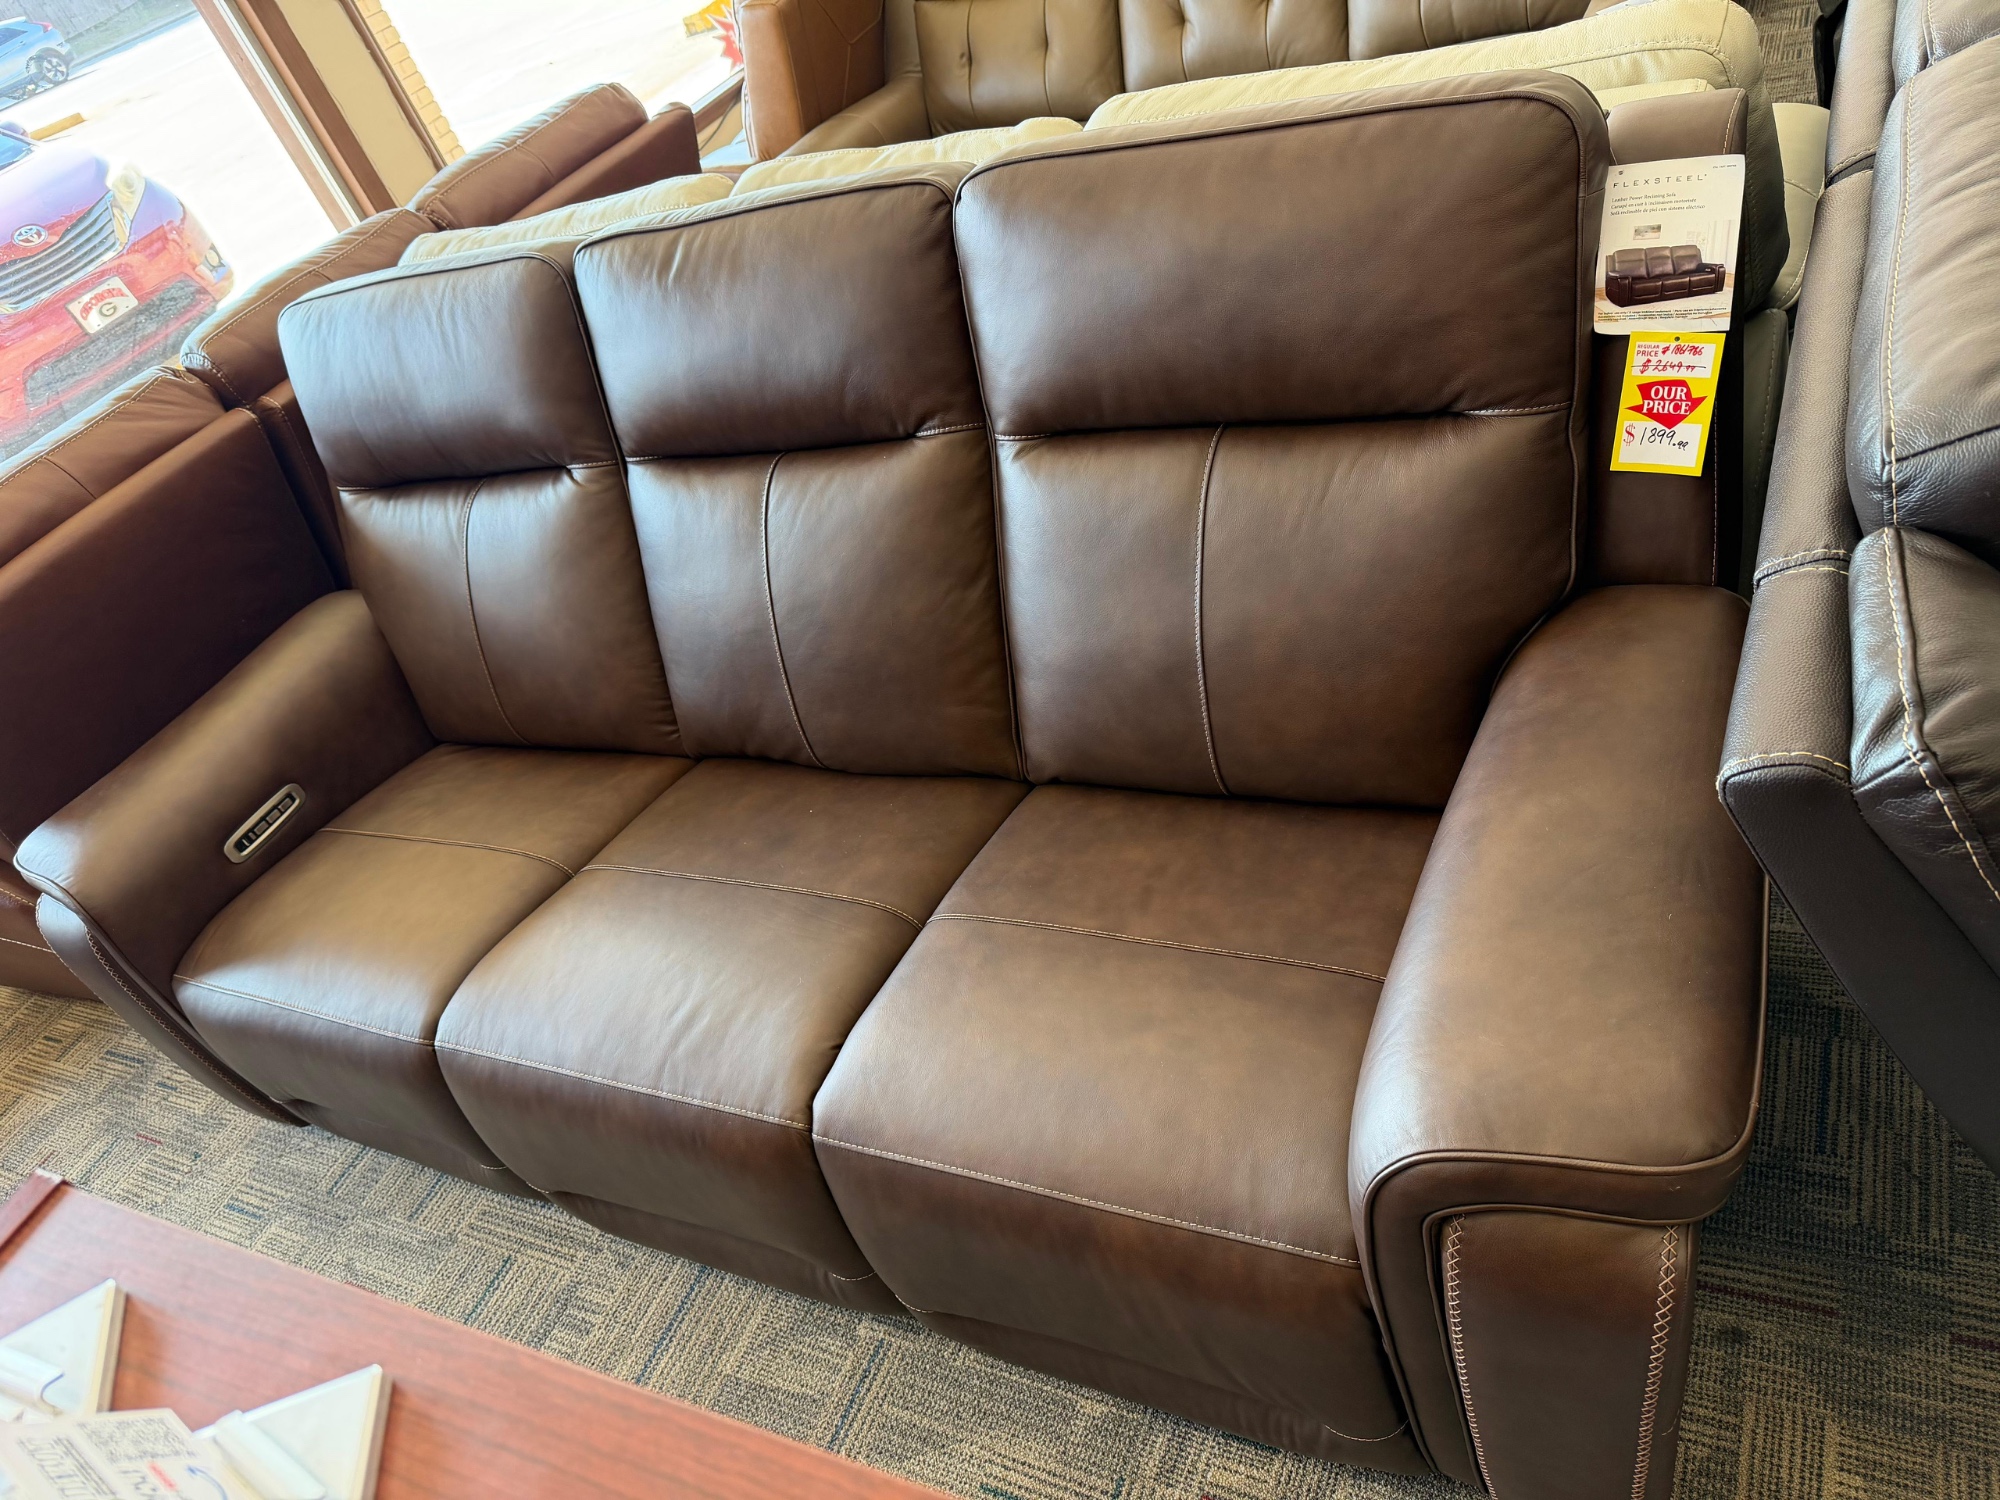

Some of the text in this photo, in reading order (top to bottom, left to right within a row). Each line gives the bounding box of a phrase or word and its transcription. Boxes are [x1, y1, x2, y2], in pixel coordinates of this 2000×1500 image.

[1613, 174, 1703, 189] FLEXSTEEL
[98, 302, 118, 318] G
[1636, 349, 1659, 358] PRICE
[1650, 385, 1687, 401] OUR
[1641, 399, 1692, 415] PRICE
